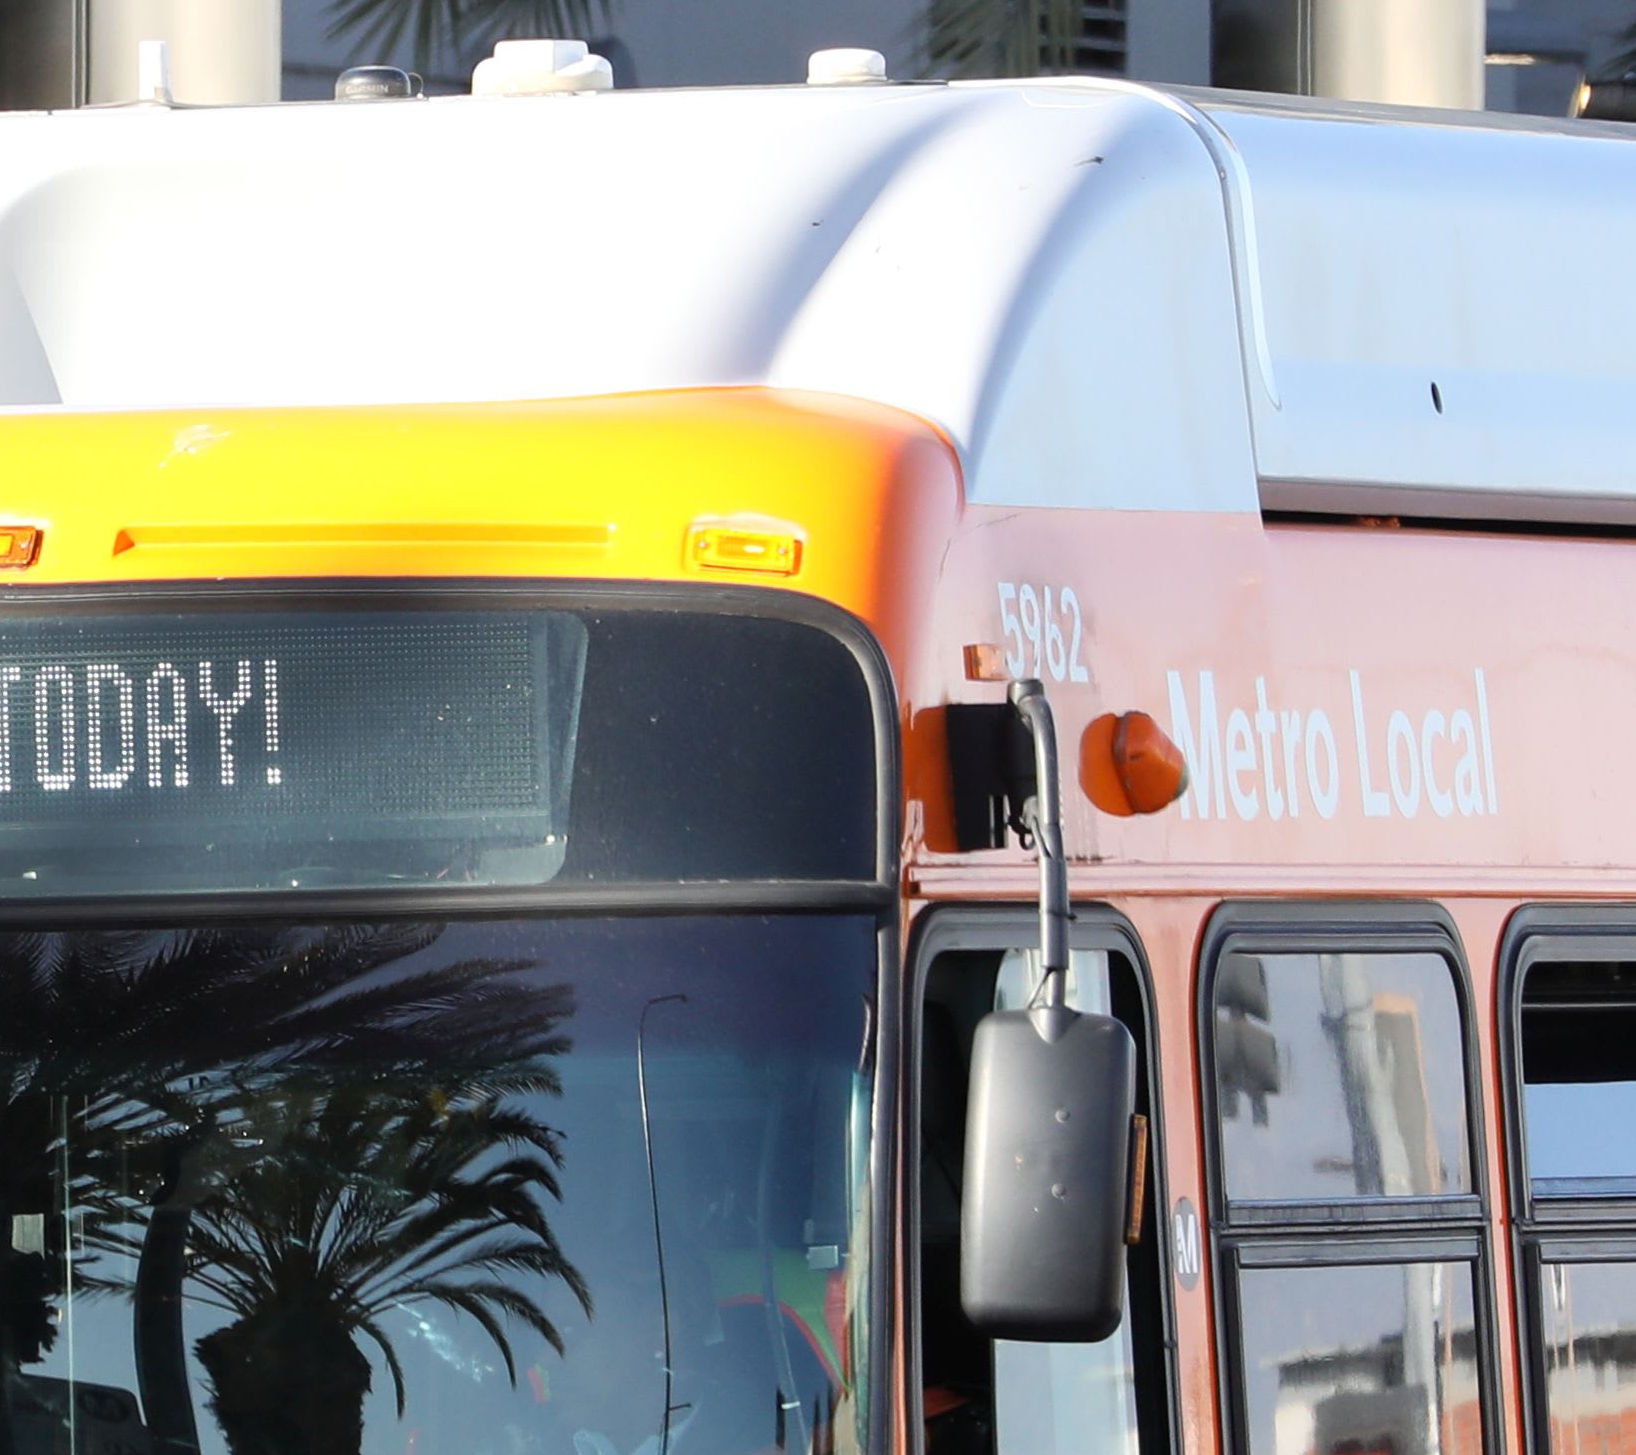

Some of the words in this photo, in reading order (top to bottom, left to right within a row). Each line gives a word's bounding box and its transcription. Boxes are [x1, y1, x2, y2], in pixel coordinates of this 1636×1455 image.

[997, 581, 1089, 683] 5962
[1166, 669, 1340, 821] Metro
[1349, 667, 1499, 820] Local
